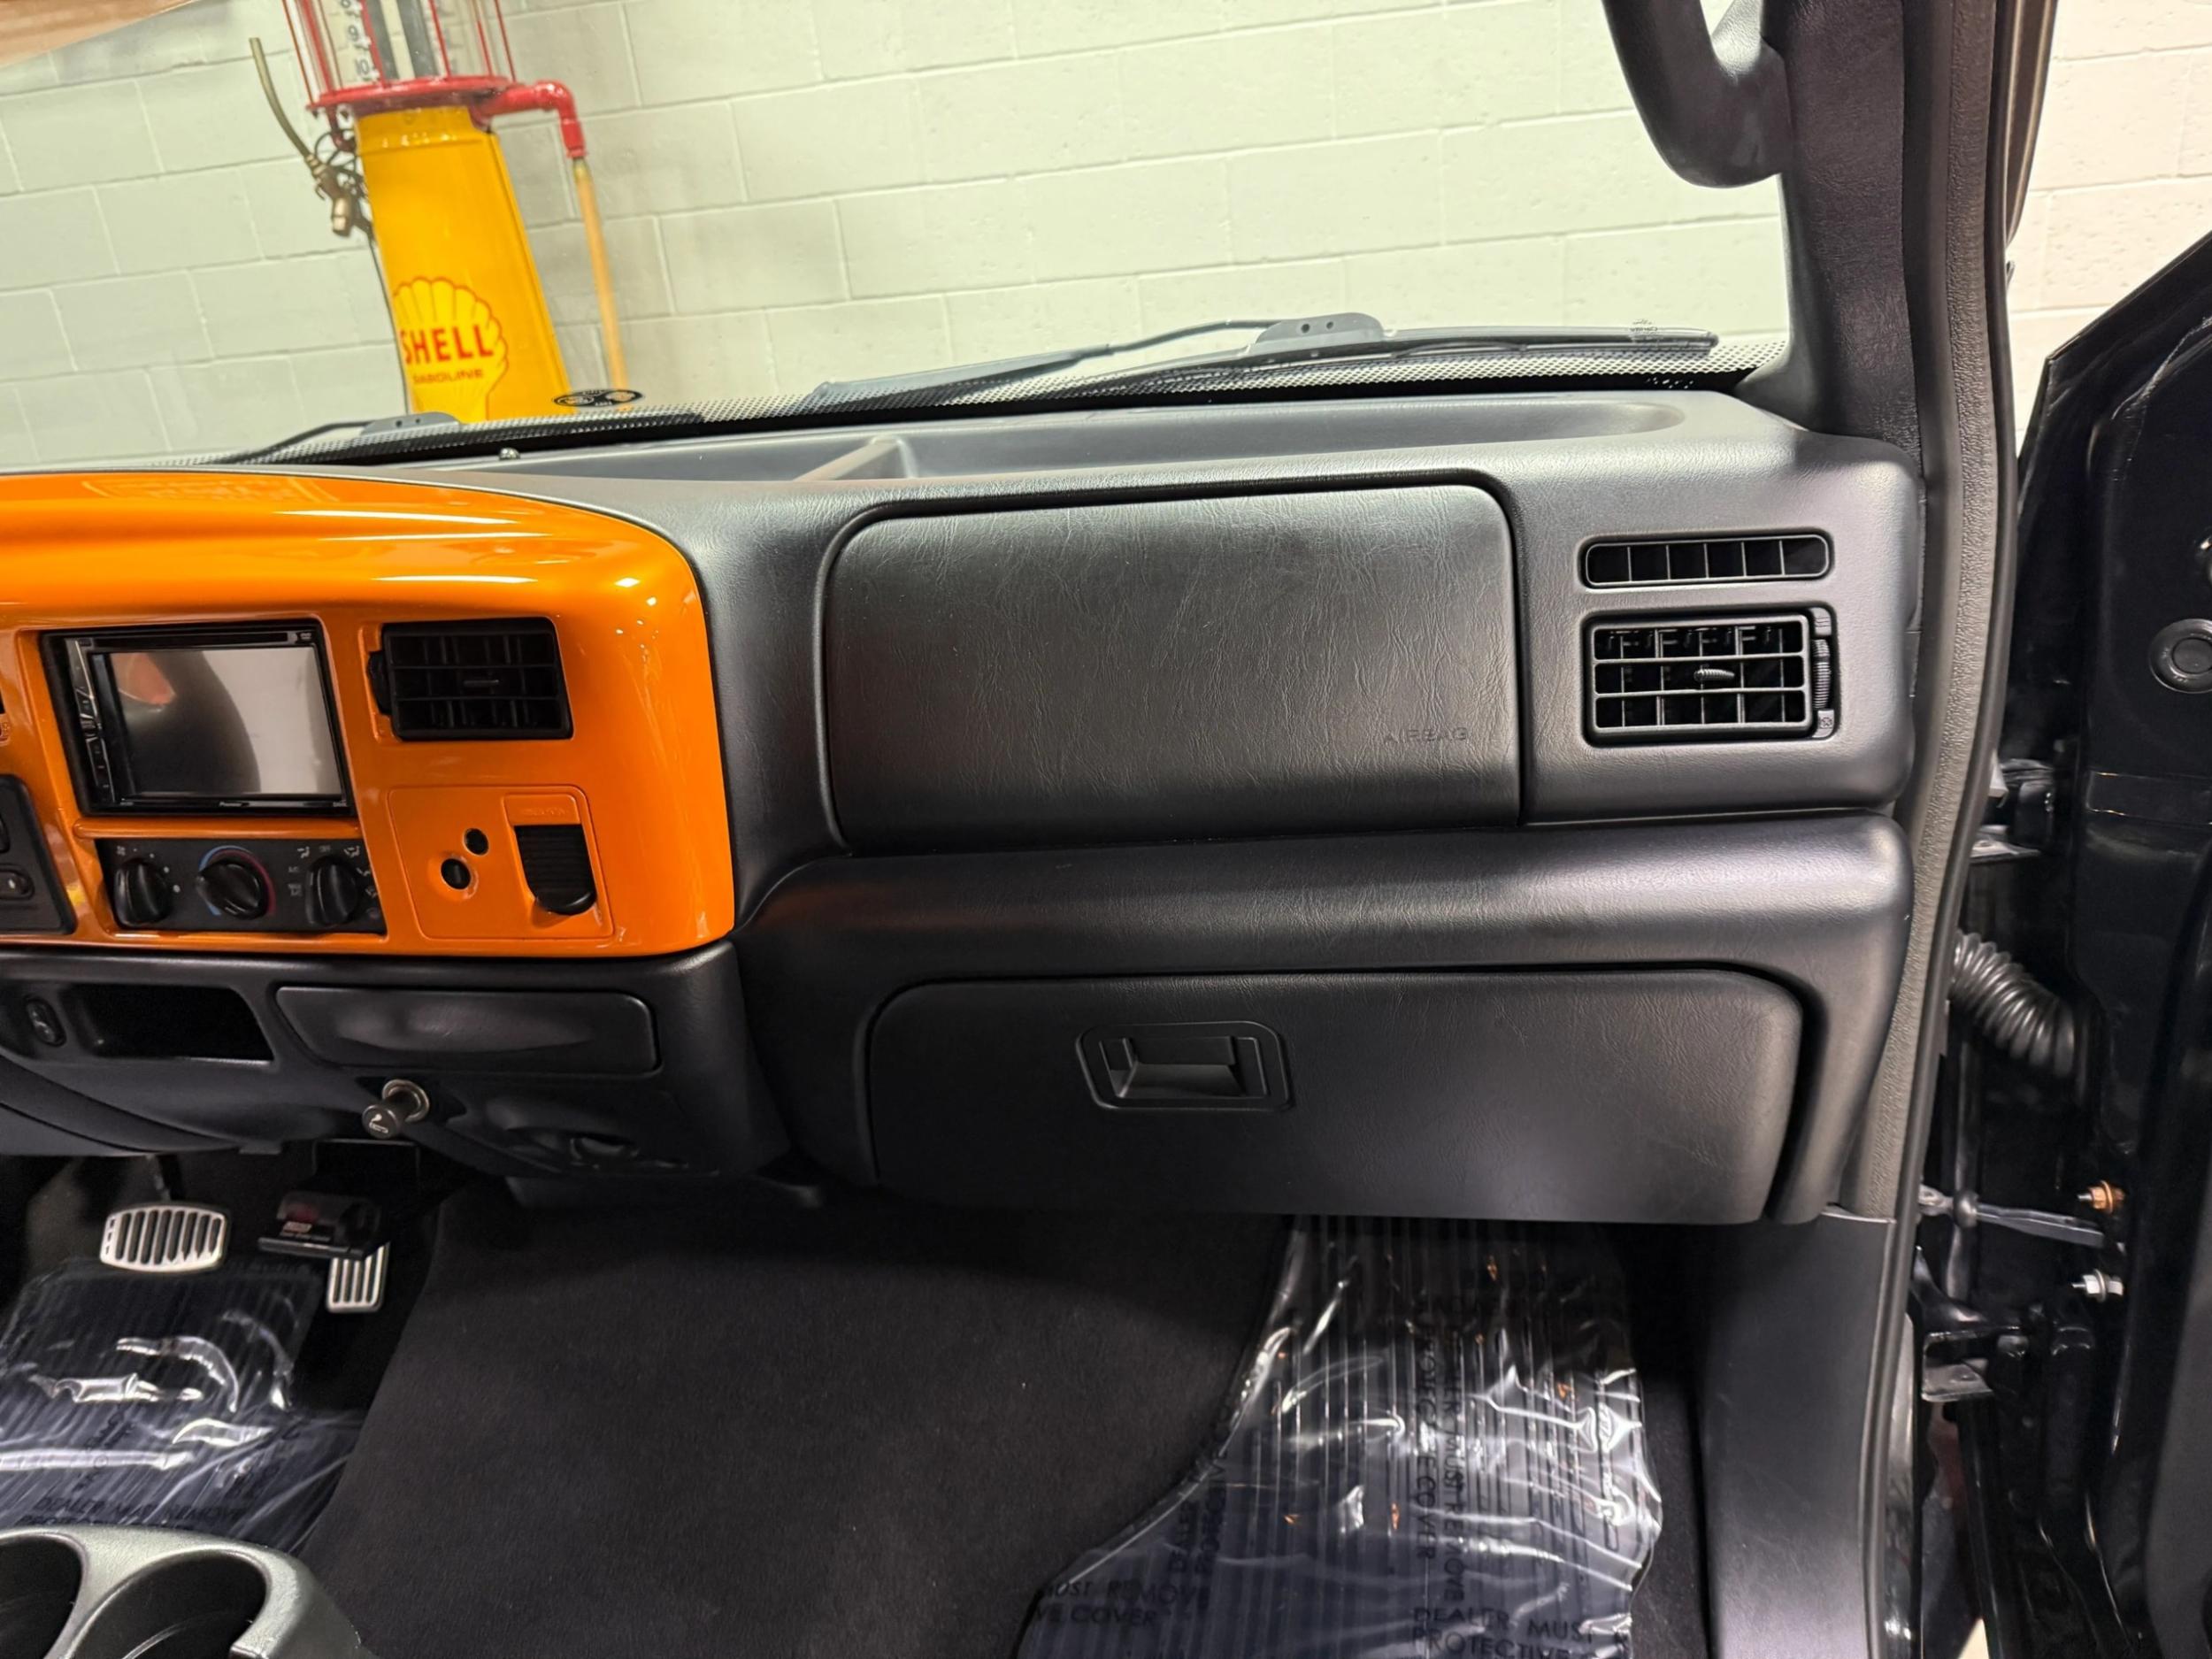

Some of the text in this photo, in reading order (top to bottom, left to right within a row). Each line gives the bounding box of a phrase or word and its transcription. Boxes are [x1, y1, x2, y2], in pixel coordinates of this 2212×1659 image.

[348, 24, 359, 42] 9
[355, 58, 370, 75] 10
[399, 324, 494, 365] SHELL
[1385, 726, 1468, 744] AIRBAG
[1416, 1476, 1437, 1560] COVER
[1070, 1603, 1158, 1626] COVER
